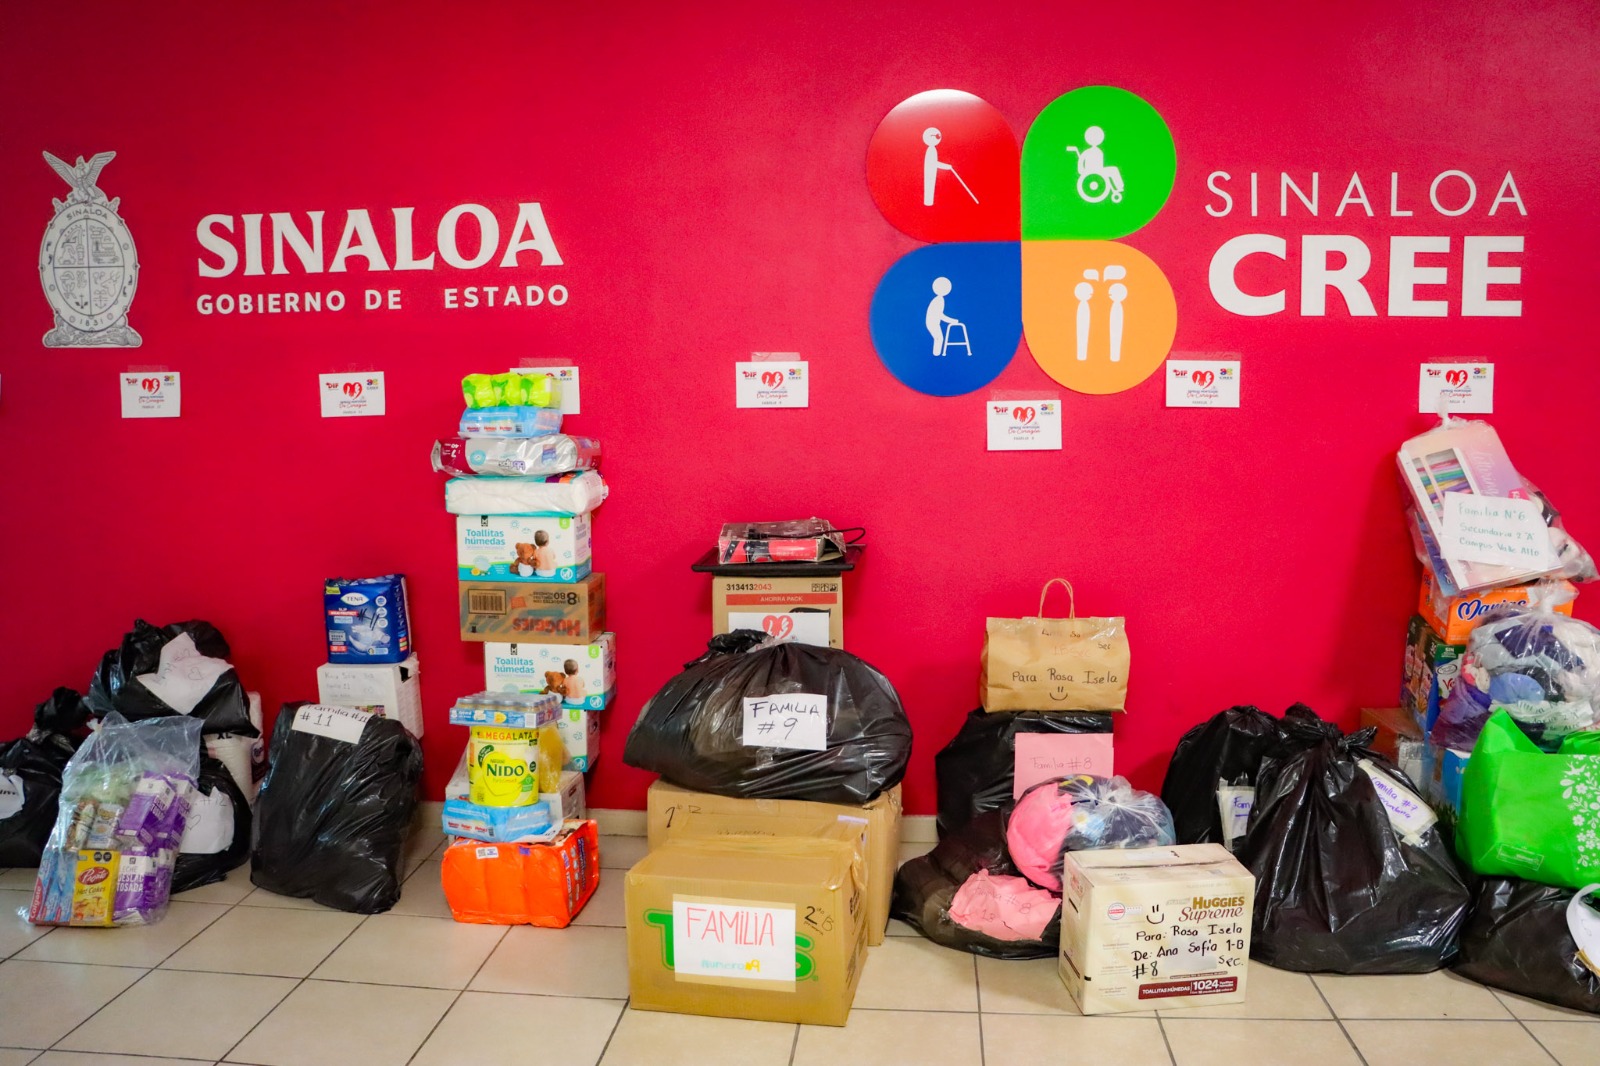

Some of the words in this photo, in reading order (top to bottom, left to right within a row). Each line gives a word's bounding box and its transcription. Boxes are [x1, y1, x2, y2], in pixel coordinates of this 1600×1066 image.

[1205, 169, 1528, 218] SINALOA
[66, 208, 108, 221] SINALOA
[196, 202, 564, 279] SINALOA
[1208, 233, 1525, 317] CREE
[197, 290, 346, 315] GOBIERNO
[364, 289, 402, 311] DE
[444, 284, 569, 310] ESTADO
[79, 317, 104, 327] 1831
[1459, 502, 1499, 517] Familia
[466, 528, 504, 537] Toallitas
[1459, 522, 1512, 538] Secundaria
[464, 537, 506, 546] húmedas
[1459, 537, 1493, 551] Campus
[1496, 542, 1516, 553] Valle
[1521, 547, 1540, 556] Alto
[726, 583, 772, 591] 3134132043
[553, 592, 566, 600] 80
[566, 592, 577, 605] 8
[512, 617, 581, 637] HUGGIES
[495, 657, 534, 666] Toallitas
[494, 665, 535, 674] húmedas
[1012, 671, 1037, 683] Para
[1047, 667, 1073, 682] Rosa
[1082, 670, 1118, 684] Isela
[749, 701, 820, 718] FAMILIA
[217, 732, 232, 740] XL
[1031, 756, 1065, 769] Familia
[486, 763, 525, 777] NIDO
[30, 886, 41, 919] Colgate
[1193, 896, 1245, 910] HUGGIES
[1178, 906, 1244, 924] Supreme
[687, 907, 774, 946] FAMILIA
[1171, 924, 1199, 936] Rosa
[1207, 922, 1242, 935] Isela
[1156, 945, 1179, 958] Ana
[1225, 939, 1244, 951] 1-B
[1142, 987, 1167, 995] TOALLITAS
[1193, 979, 1219, 991] 1024
